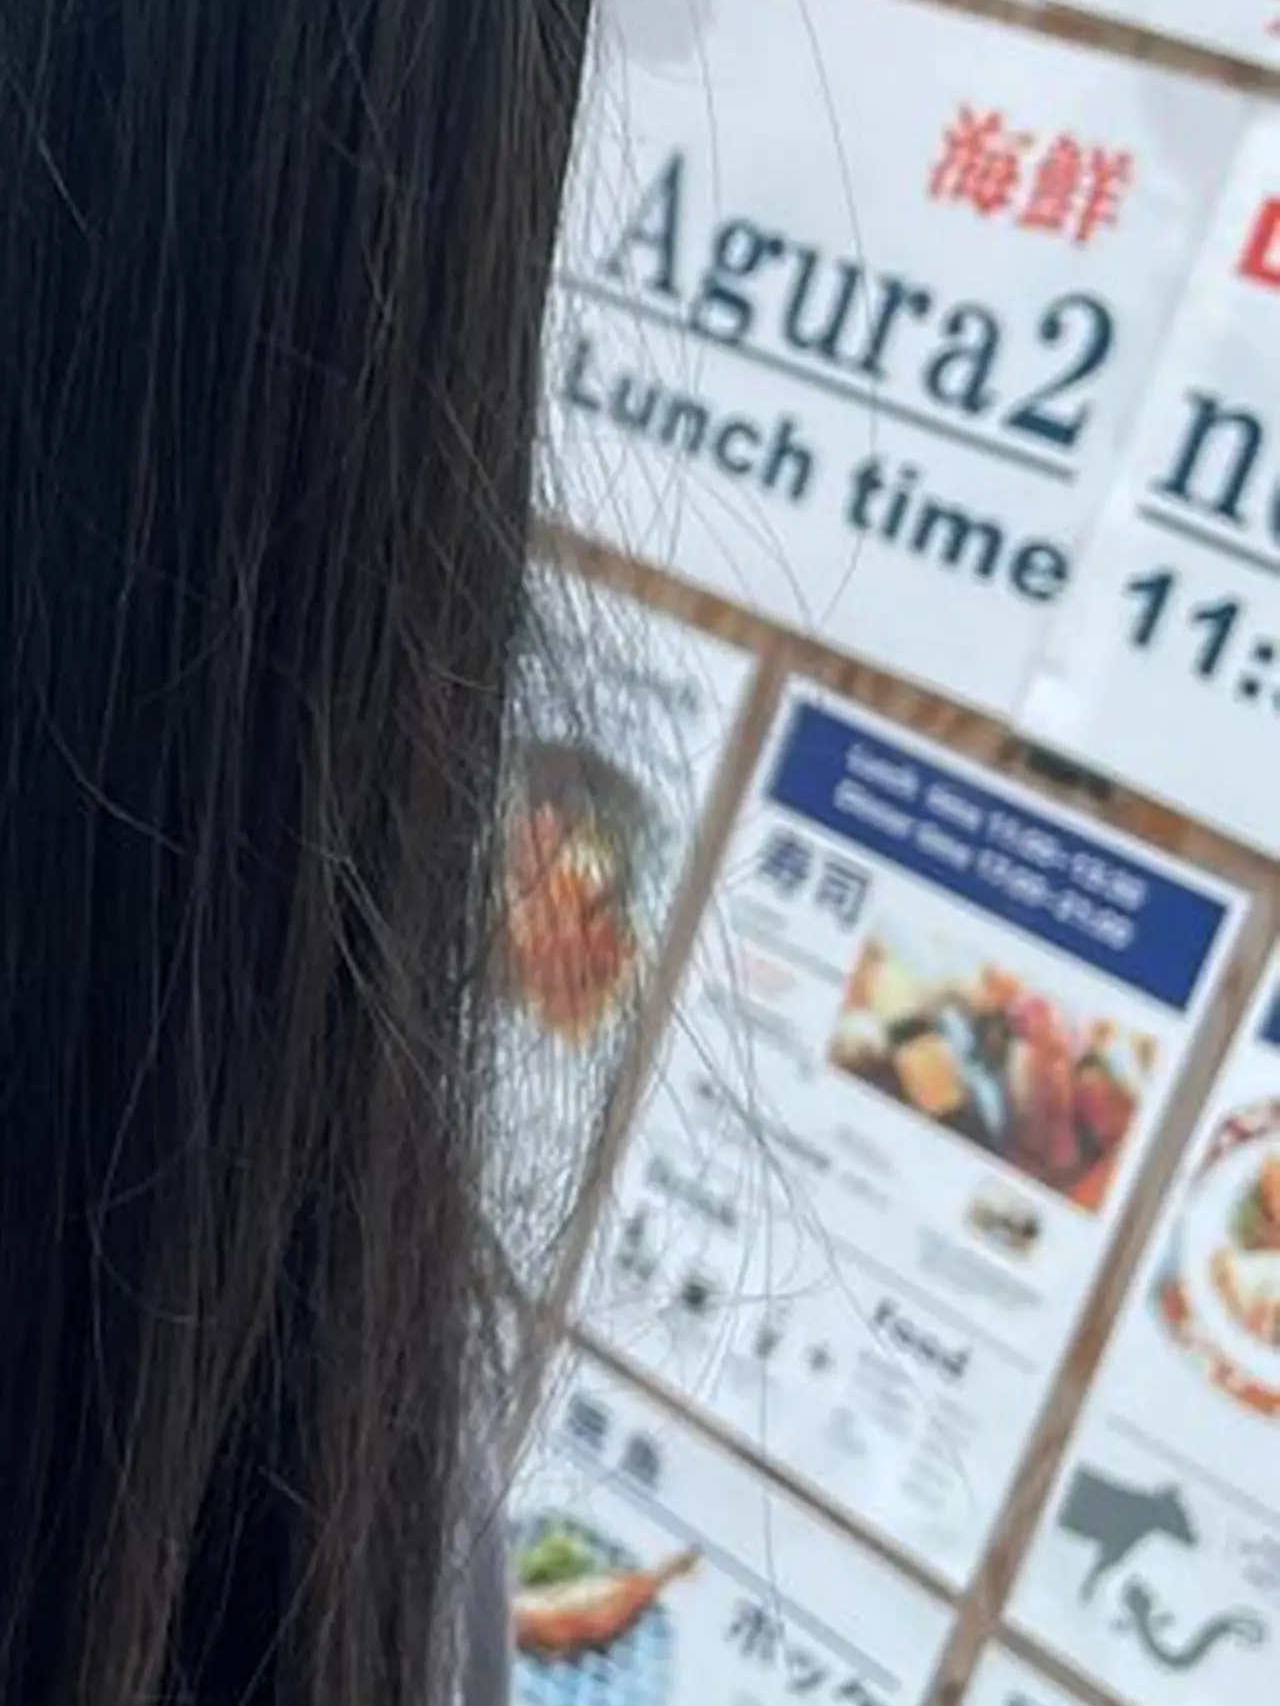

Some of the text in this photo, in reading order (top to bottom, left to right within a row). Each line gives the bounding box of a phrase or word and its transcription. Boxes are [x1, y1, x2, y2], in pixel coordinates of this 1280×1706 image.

[925, 101, 1131, 247] 海鮮
[598, 145, 1116, 452] Agura2
[565, 337, 1280, 718] Lunch time 11:
[753, 826, 873, 931] 寿司
[870, 1296, 973, 1380] Food
